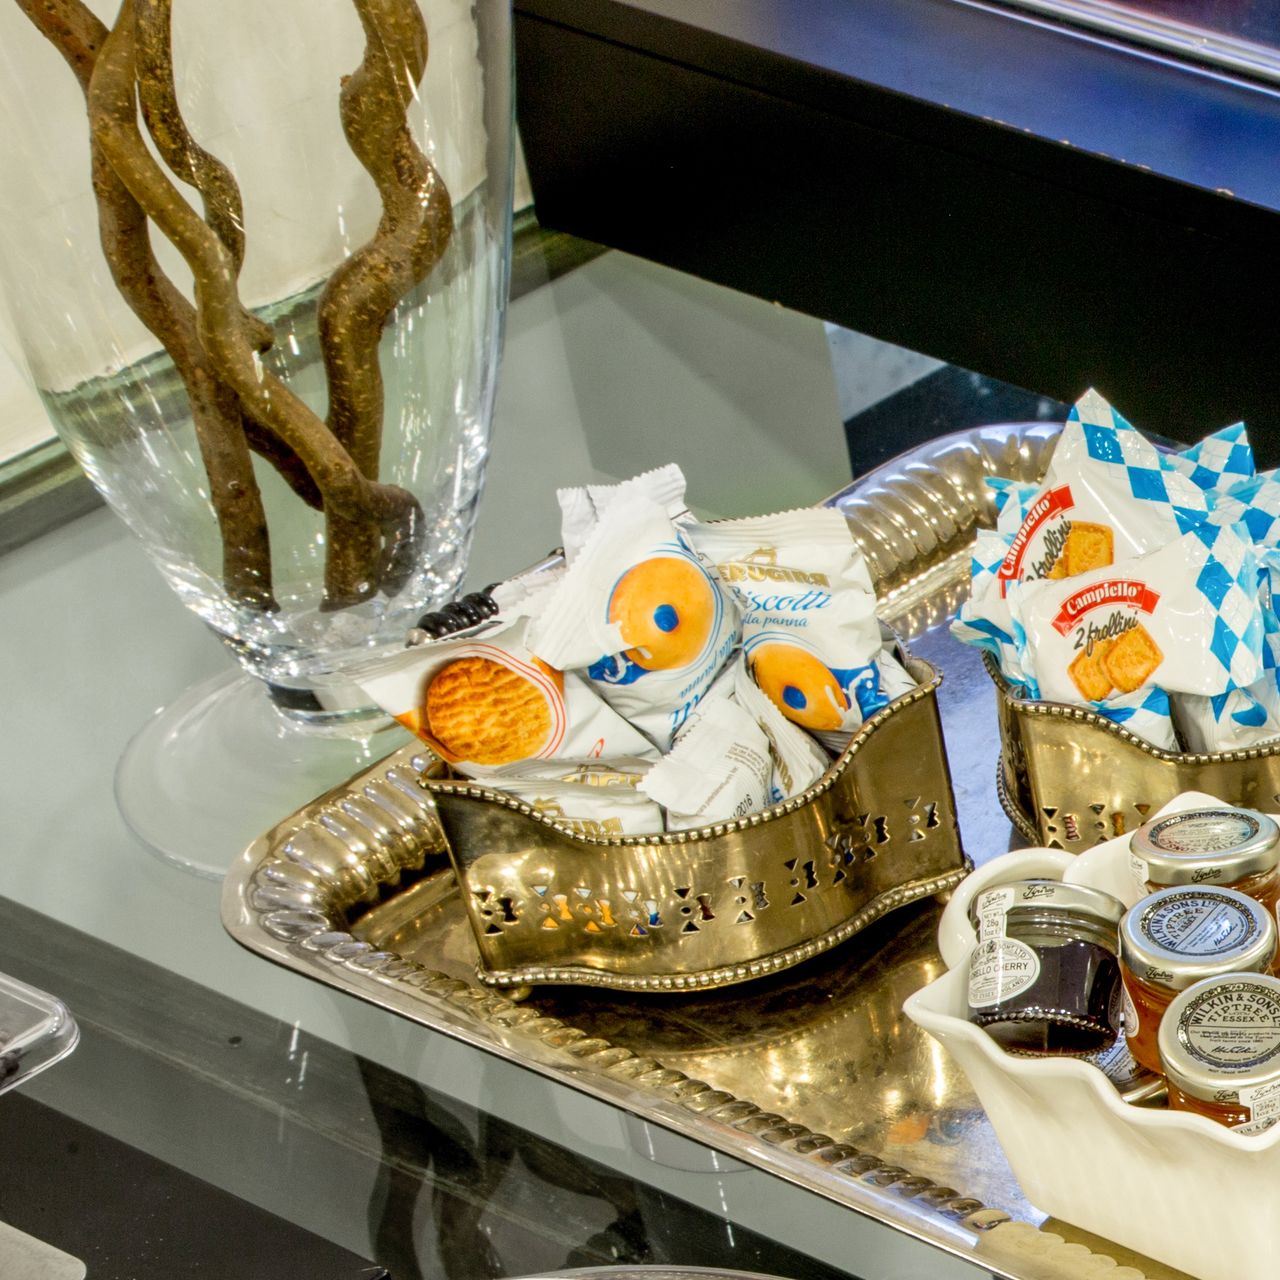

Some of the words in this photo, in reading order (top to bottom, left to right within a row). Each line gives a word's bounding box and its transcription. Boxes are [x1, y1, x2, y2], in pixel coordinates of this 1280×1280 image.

[1000, 495, 1051, 576] Campiello
[1067, 583, 1138, 615] Campiello
[1074, 627, 1085, 649] 2
[1086, 611, 1139, 657] frollini
[1152, 920, 1177, 948] WILKIN
[1166, 900, 1199, 915] SONS
[1166, 908, 1205, 939] TIPTREE
[1190, 994, 1235, 1026] WILKIN
[1247, 994, 1280, 1014] SONS
[1207, 1004, 1270, 1023] TIPTREE
